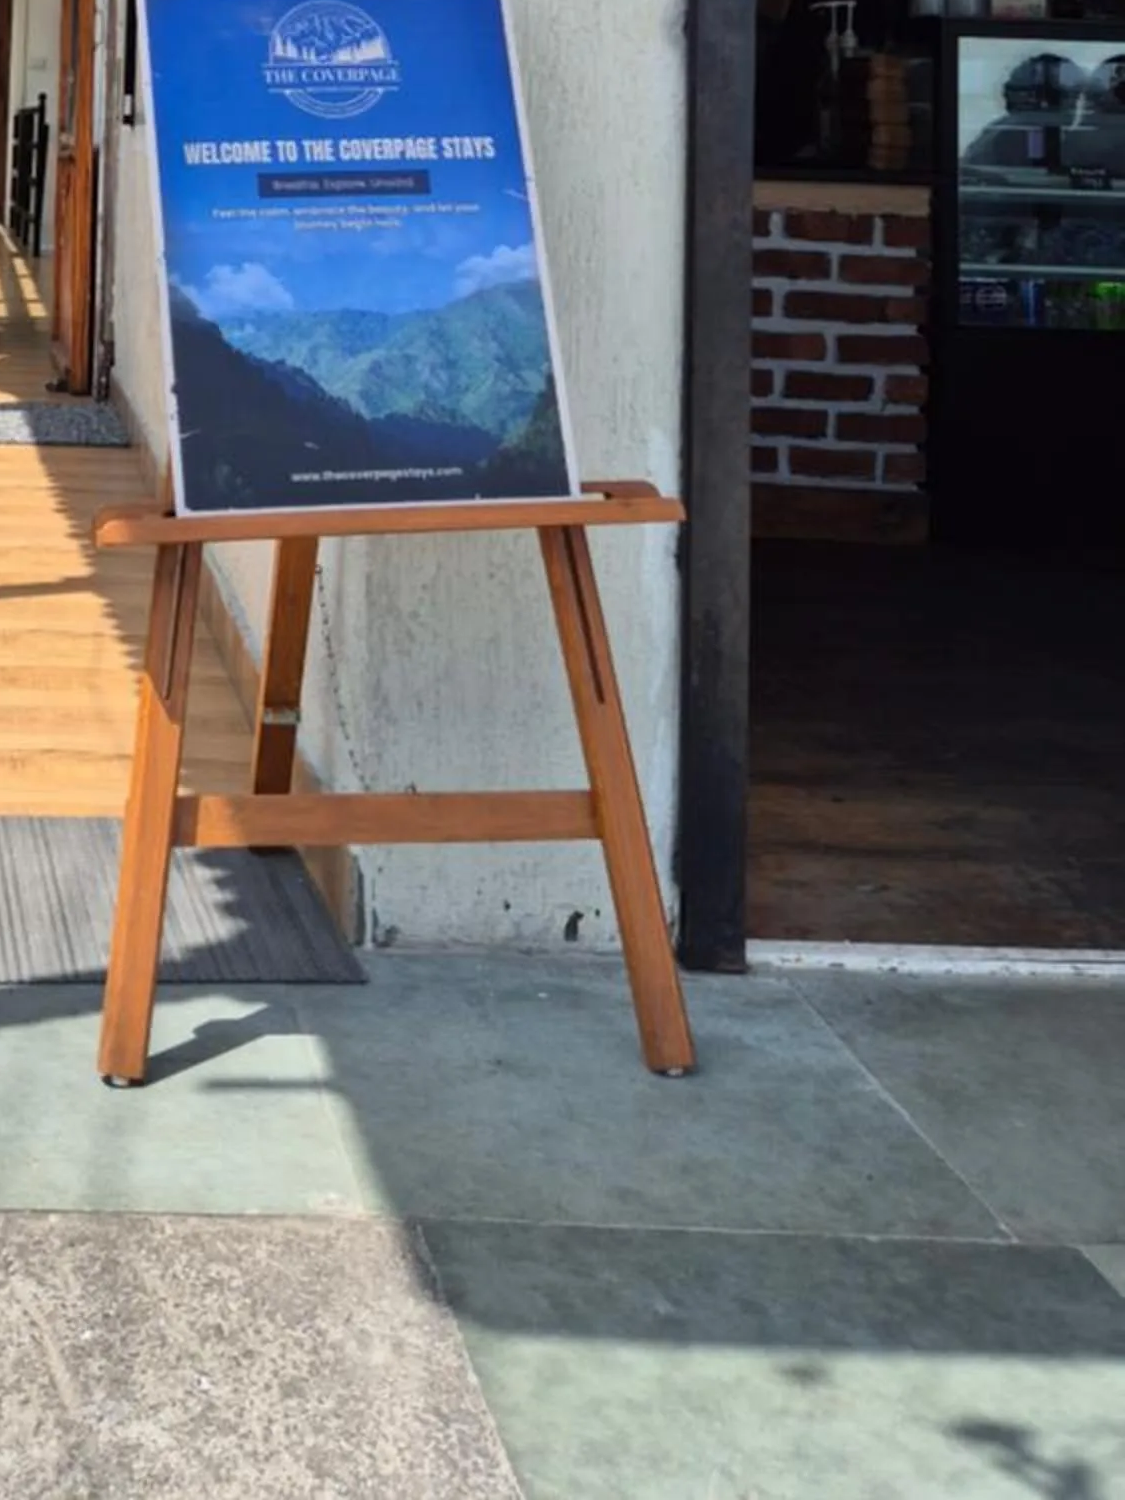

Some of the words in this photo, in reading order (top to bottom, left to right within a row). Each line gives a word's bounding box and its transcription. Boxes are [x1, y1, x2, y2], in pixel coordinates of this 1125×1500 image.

[264, 69, 299, 84] THE
[301, 67, 401, 83] COVERPAGE
[183, 140, 273, 165] WELCOME
[274, 139, 299, 163] TO
[302, 137, 336, 162] THE
[338, 135, 439, 161] COVERPAGE
[441, 135, 496, 160] STAYS
[291, 467, 463, 482] www.thecoverpagestays.com
